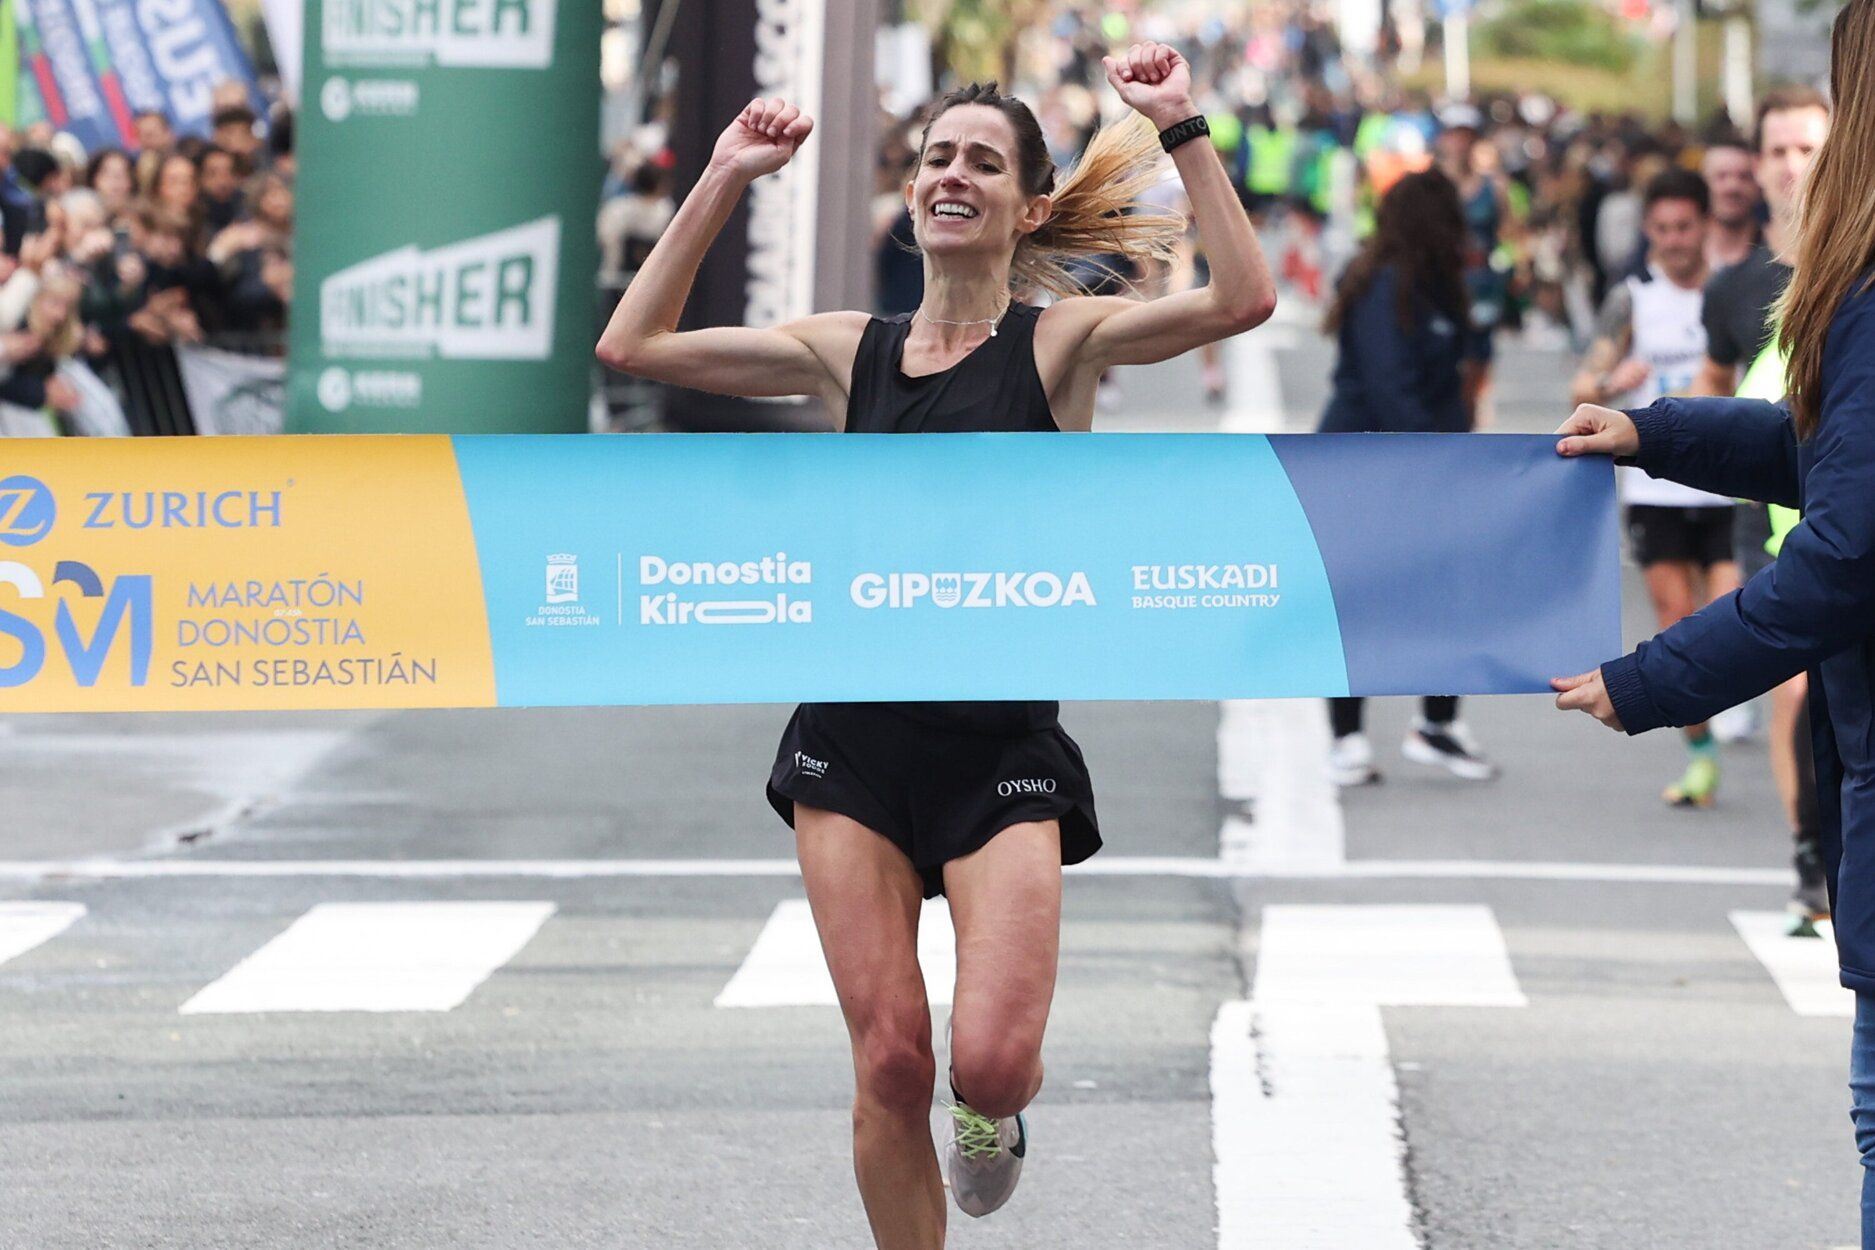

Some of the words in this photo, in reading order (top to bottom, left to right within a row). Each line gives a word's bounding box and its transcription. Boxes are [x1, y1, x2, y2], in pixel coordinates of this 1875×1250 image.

[82, 490, 282, 529] ZURICH
[639, 551, 812, 586] Donostia
[1130, 563, 1279, 591] EUSKADI
[186, 573, 364, 608] MARATÓN
[849, 571, 1098, 609] GIPUZKOA
[1131, 594, 1198, 609] BASQUE
[1200, 593, 1281, 608] COUNTRY
[525, 617, 547, 626] SAN
[538, 605, 586, 616] DONOSTIA
[639, 592, 813, 625] Kirola
[177, 618, 366, 648] DONOSTIA
[171, 660, 241, 688] SAN
[252, 652, 437, 687] SEBASTIÁN
[801, 753, 829, 770] VICKY
[997, 777, 1057, 797] OYSHO
